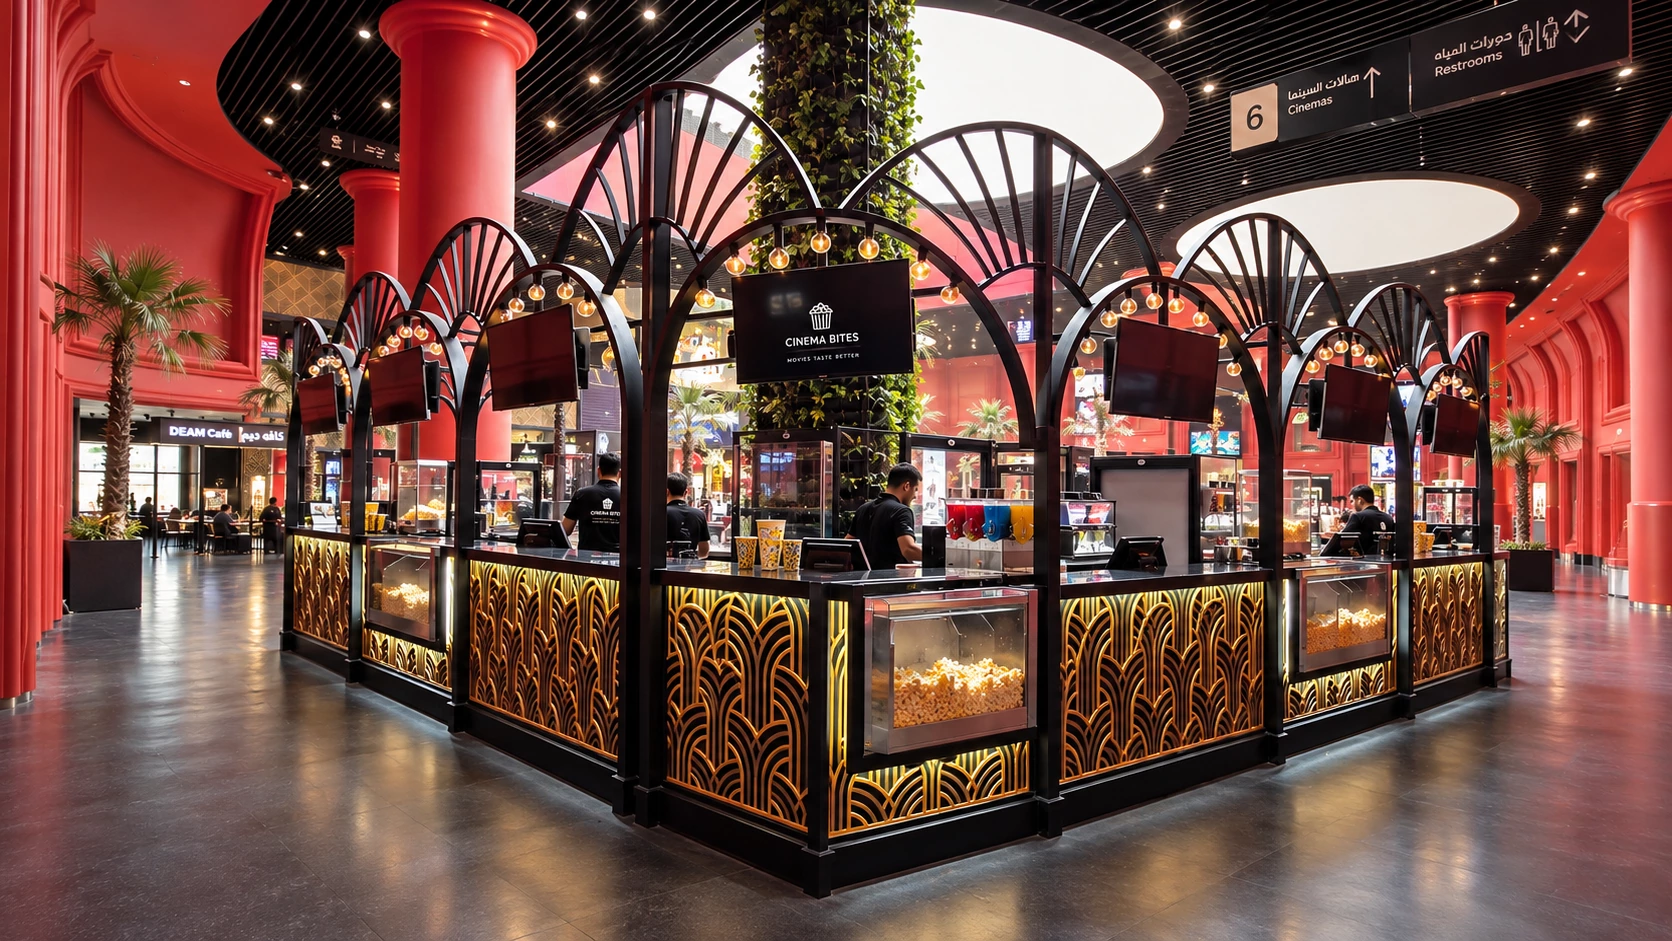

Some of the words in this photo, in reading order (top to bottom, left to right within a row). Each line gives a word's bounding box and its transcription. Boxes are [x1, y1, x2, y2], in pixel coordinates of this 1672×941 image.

[1434, 42, 1467, 60] المياه
[1435, 51, 1503, 77] Restrooms
[1288, 82, 1323, 101] السينما
[1287, 96, 1333, 115] Cinemas
[1246, 104, 1264, 131] 6
[785, 335, 827, 347] CINEMA
[829, 332, 860, 344] BITES
[169, 425, 206, 438] DEAM
[207, 428, 233, 439] Café
